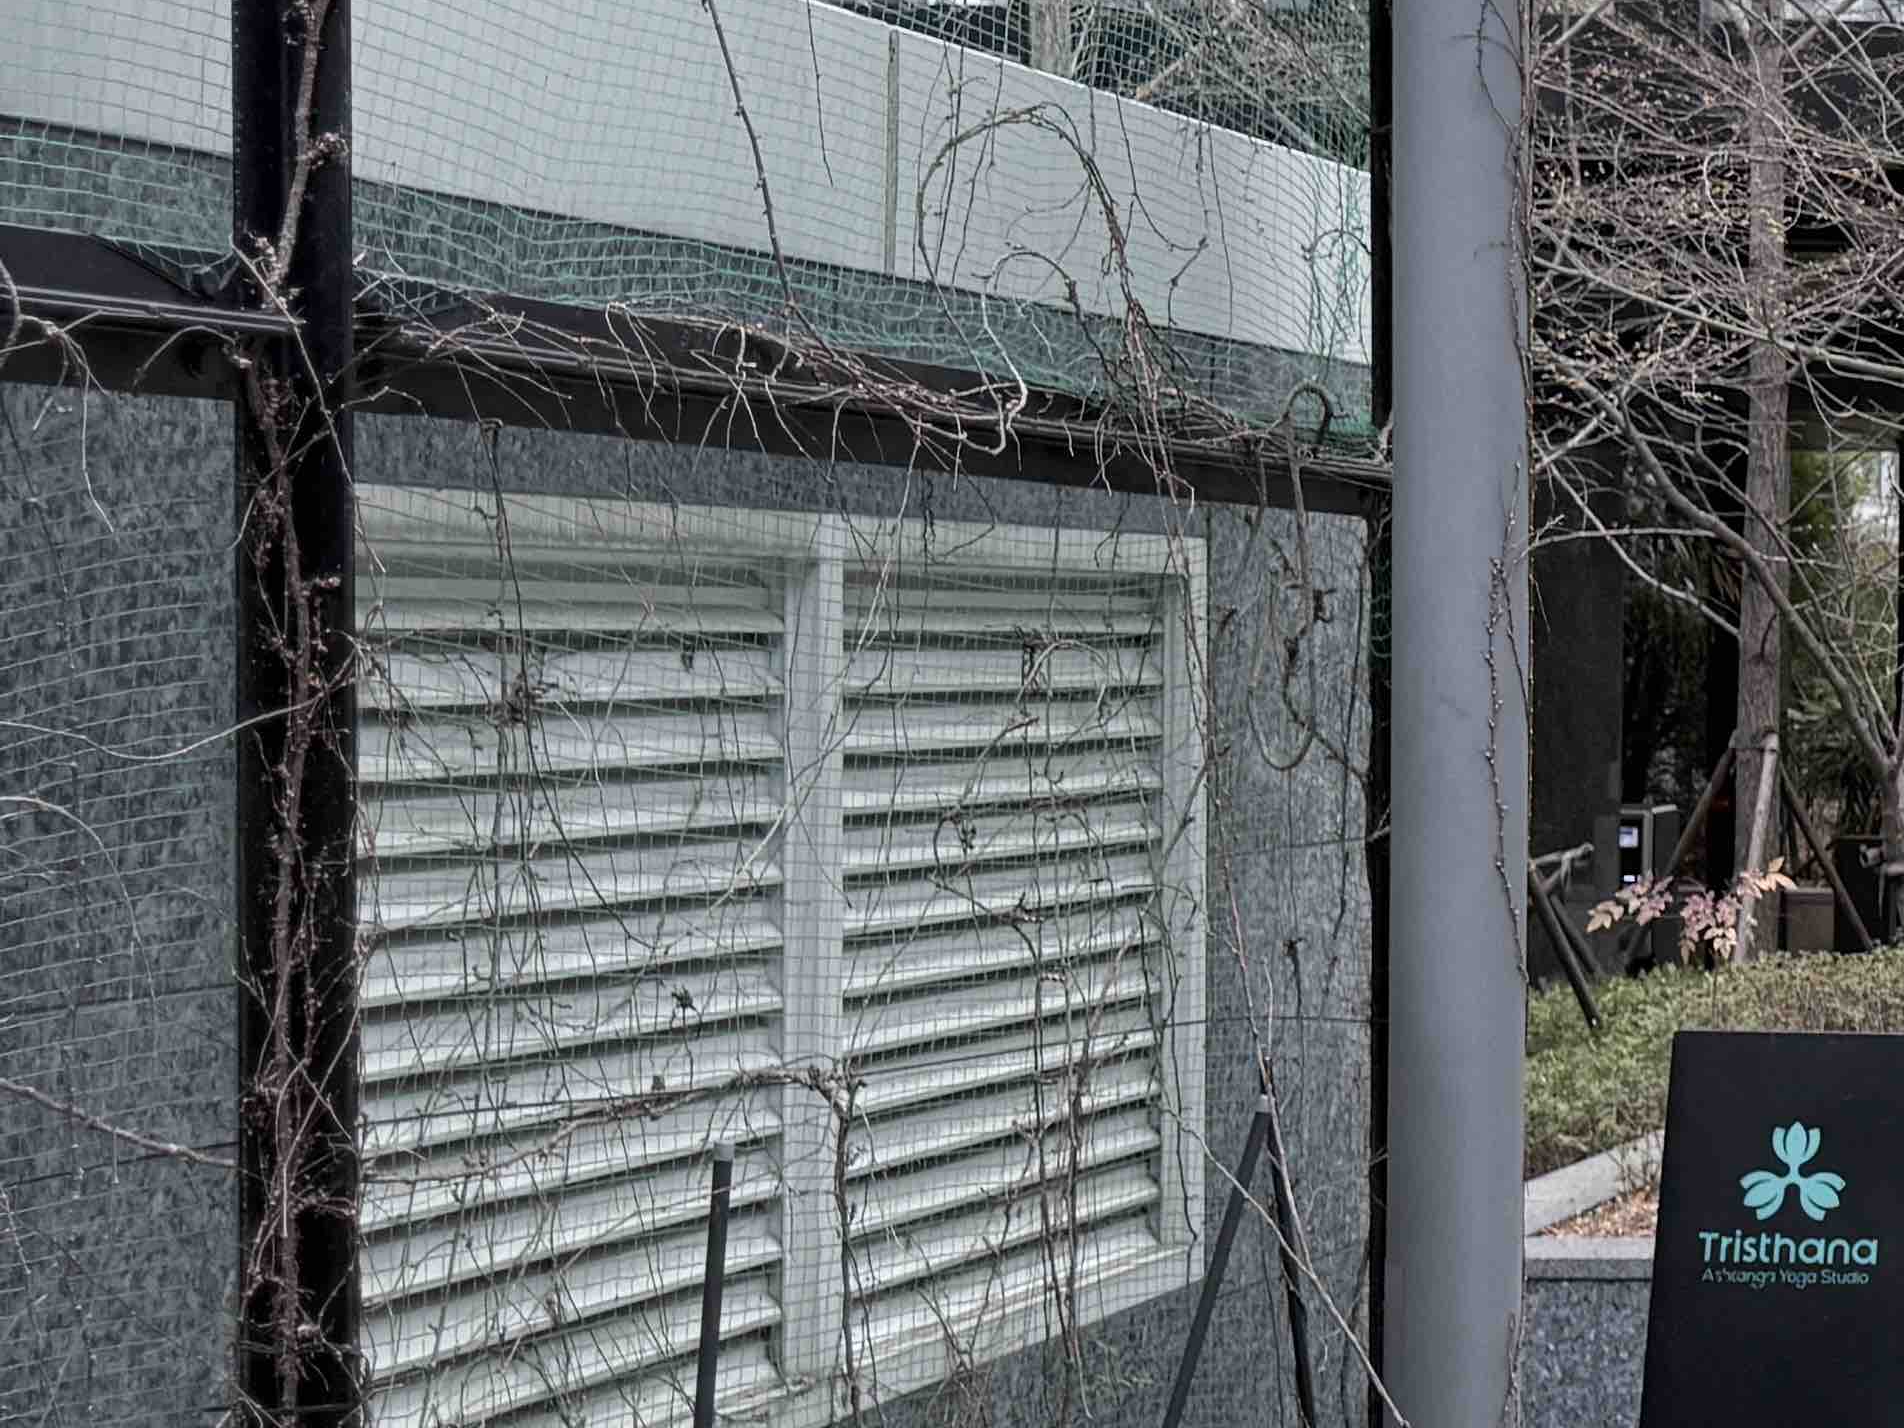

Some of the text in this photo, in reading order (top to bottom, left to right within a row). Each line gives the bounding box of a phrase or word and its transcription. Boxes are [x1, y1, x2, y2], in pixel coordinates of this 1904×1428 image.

[1699, 1229, 1878, 1265] Tristhana
[1779, 1269, 1817, 1289] Yoga
[1820, 1269, 1869, 1284] Studio
